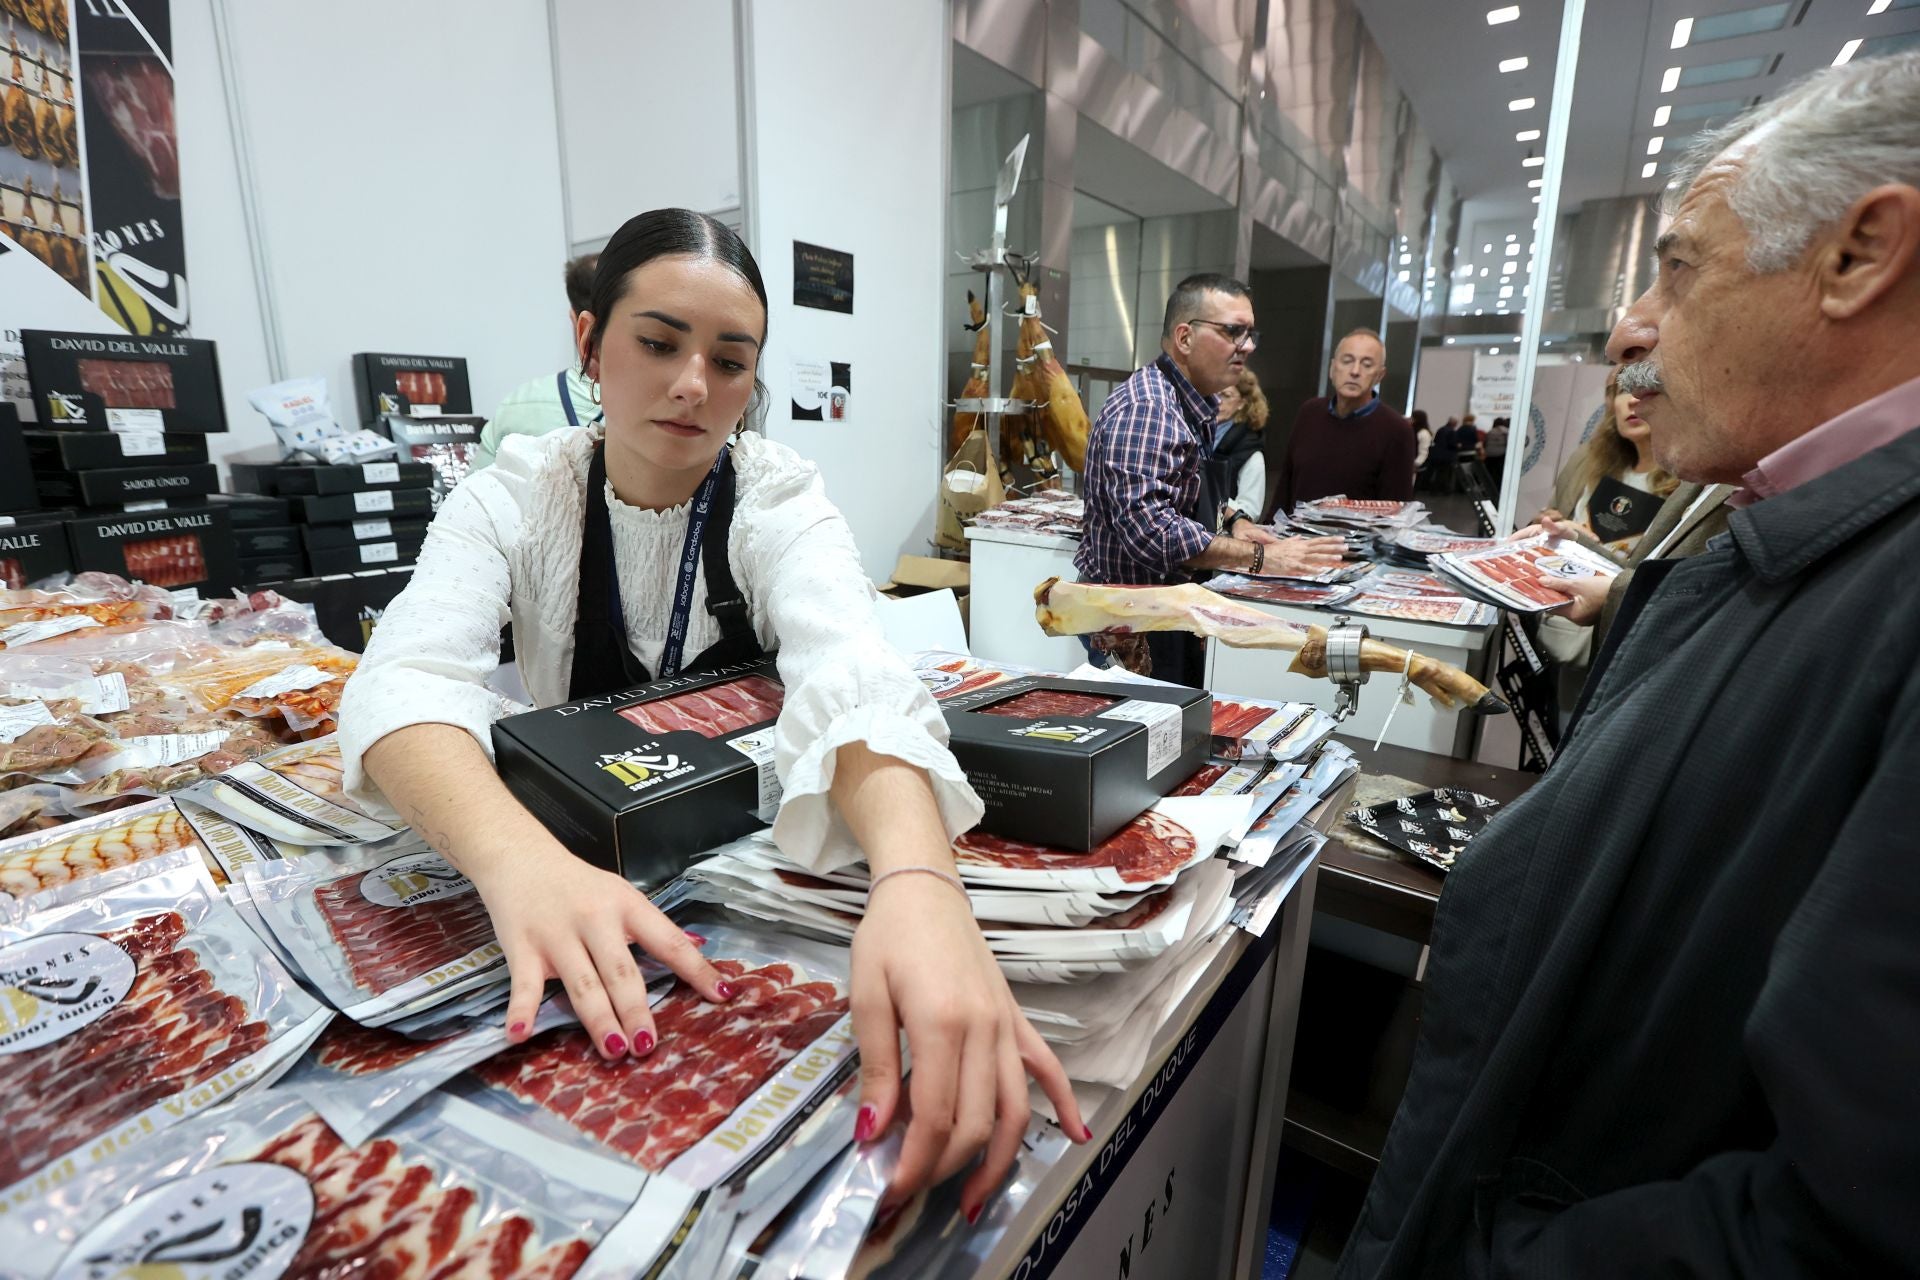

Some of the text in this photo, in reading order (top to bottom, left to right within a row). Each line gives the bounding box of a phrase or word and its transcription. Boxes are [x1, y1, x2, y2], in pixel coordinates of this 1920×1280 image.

[51, 338, 189, 356] DAVID DEL VALLE
[817, 391, 829, 399] 10€
[405, 423, 476, 435] David Del Valle
[98, 514, 213, 538] DAVID DEL VALLE
[554, 657, 774, 718] DAVID DEL VALLE
[629, 763, 697, 793] sabor único
[254, 774, 301, 802] David
[297, 794, 323, 816] del
[402, 888, 442, 906] sabor
[90, 1115, 155, 1164] del
[163, 1062, 256, 1118] Valle
[712, 1082, 802, 1153] David
[791, 1047, 840, 1083] del
[1099, 1115, 1138, 1177] DEL
[1141, 1024, 1199, 1118] DUQUE
